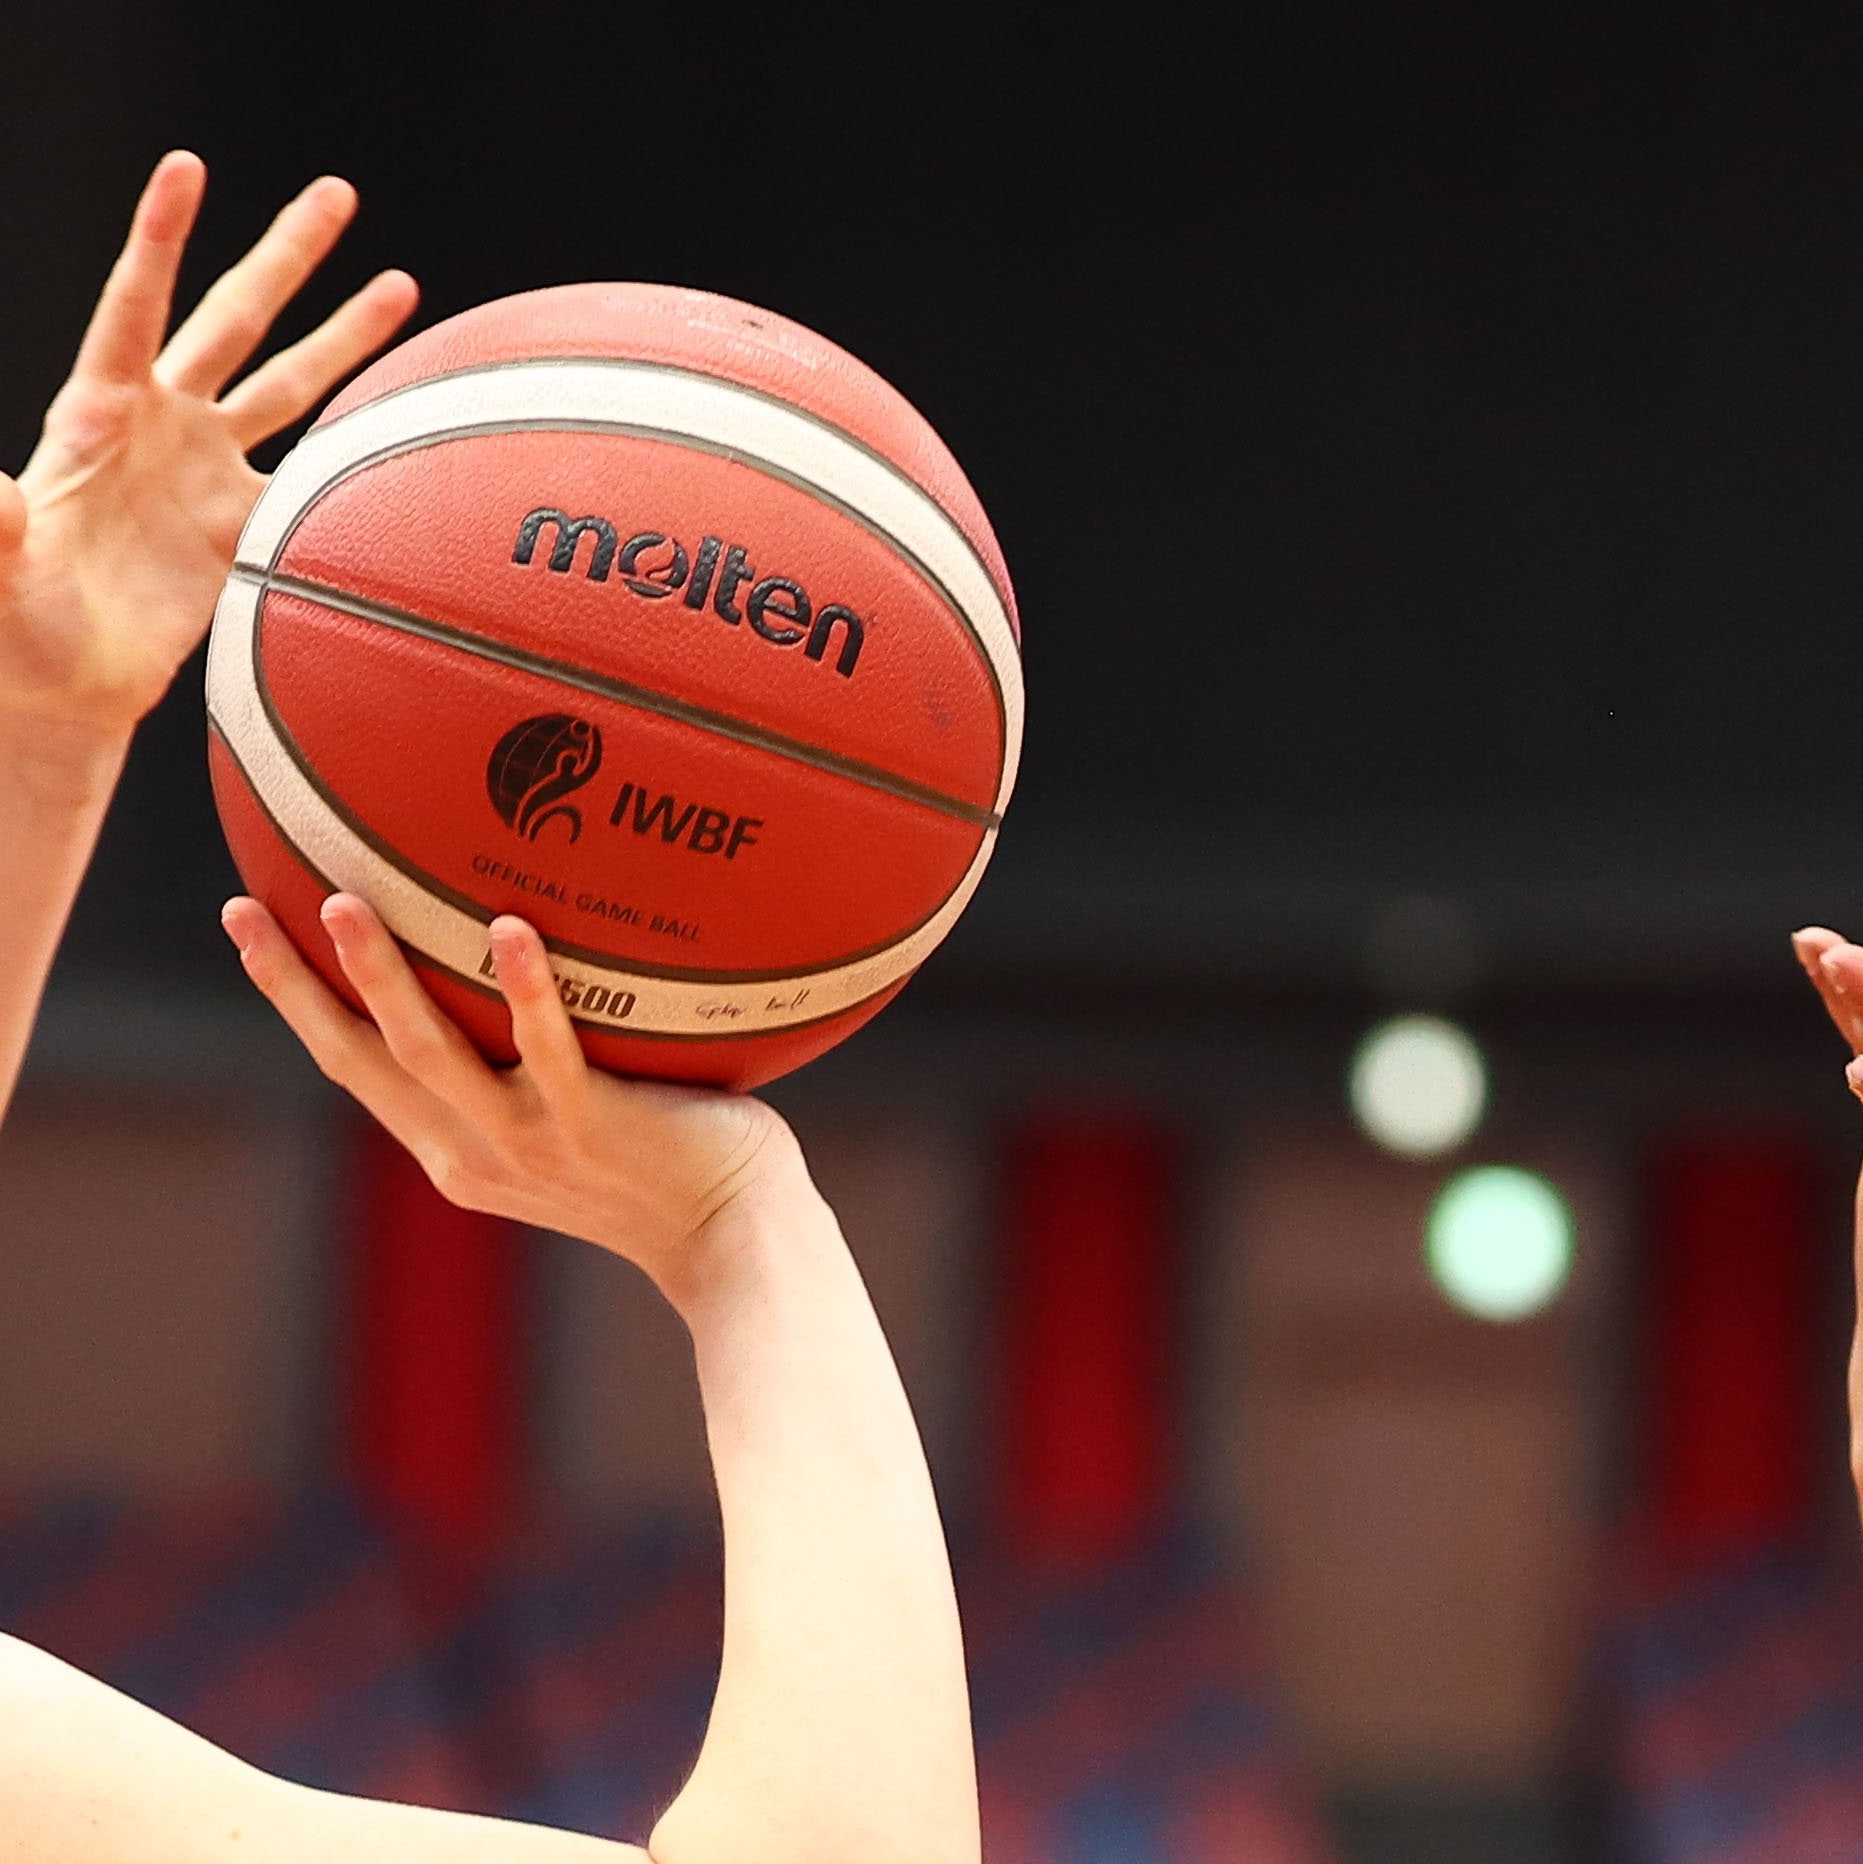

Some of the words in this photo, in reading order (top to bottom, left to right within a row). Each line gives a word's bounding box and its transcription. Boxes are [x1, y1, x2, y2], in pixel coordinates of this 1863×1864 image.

[511, 507, 864, 679] molten
[609, 783, 764, 860] IWBF
[471, 854, 566, 902] OFFICIAL
[574, 893, 643, 928] GAME
[649, 914, 702, 943] BALL
